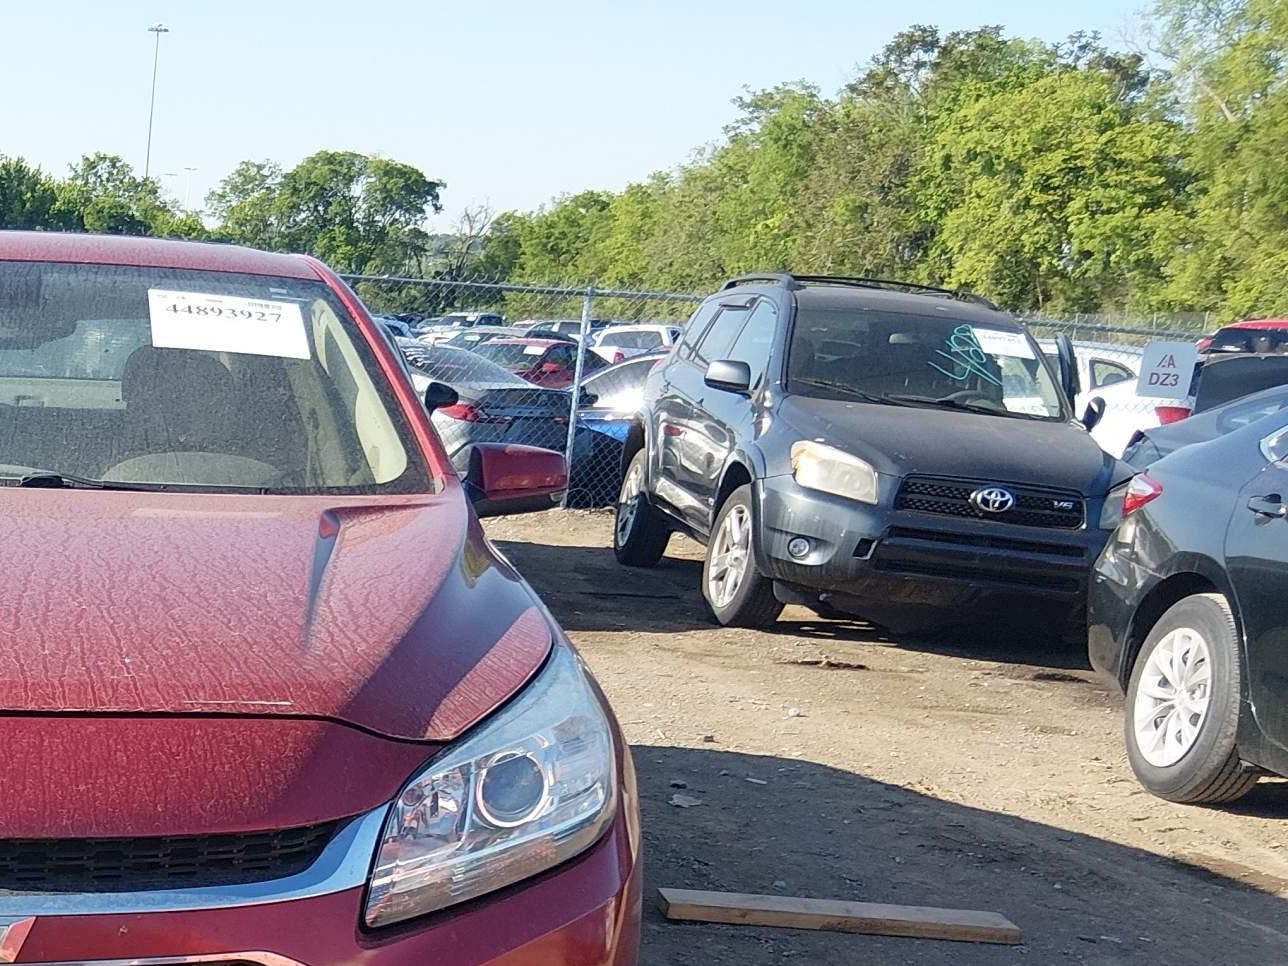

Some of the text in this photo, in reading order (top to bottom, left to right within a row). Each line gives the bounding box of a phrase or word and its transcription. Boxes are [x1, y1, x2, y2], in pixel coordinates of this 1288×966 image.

[165, 303, 282, 322] 44893927
[1148, 372, 1180, 387] DZ3
[1052, 500, 1074, 510] V6
